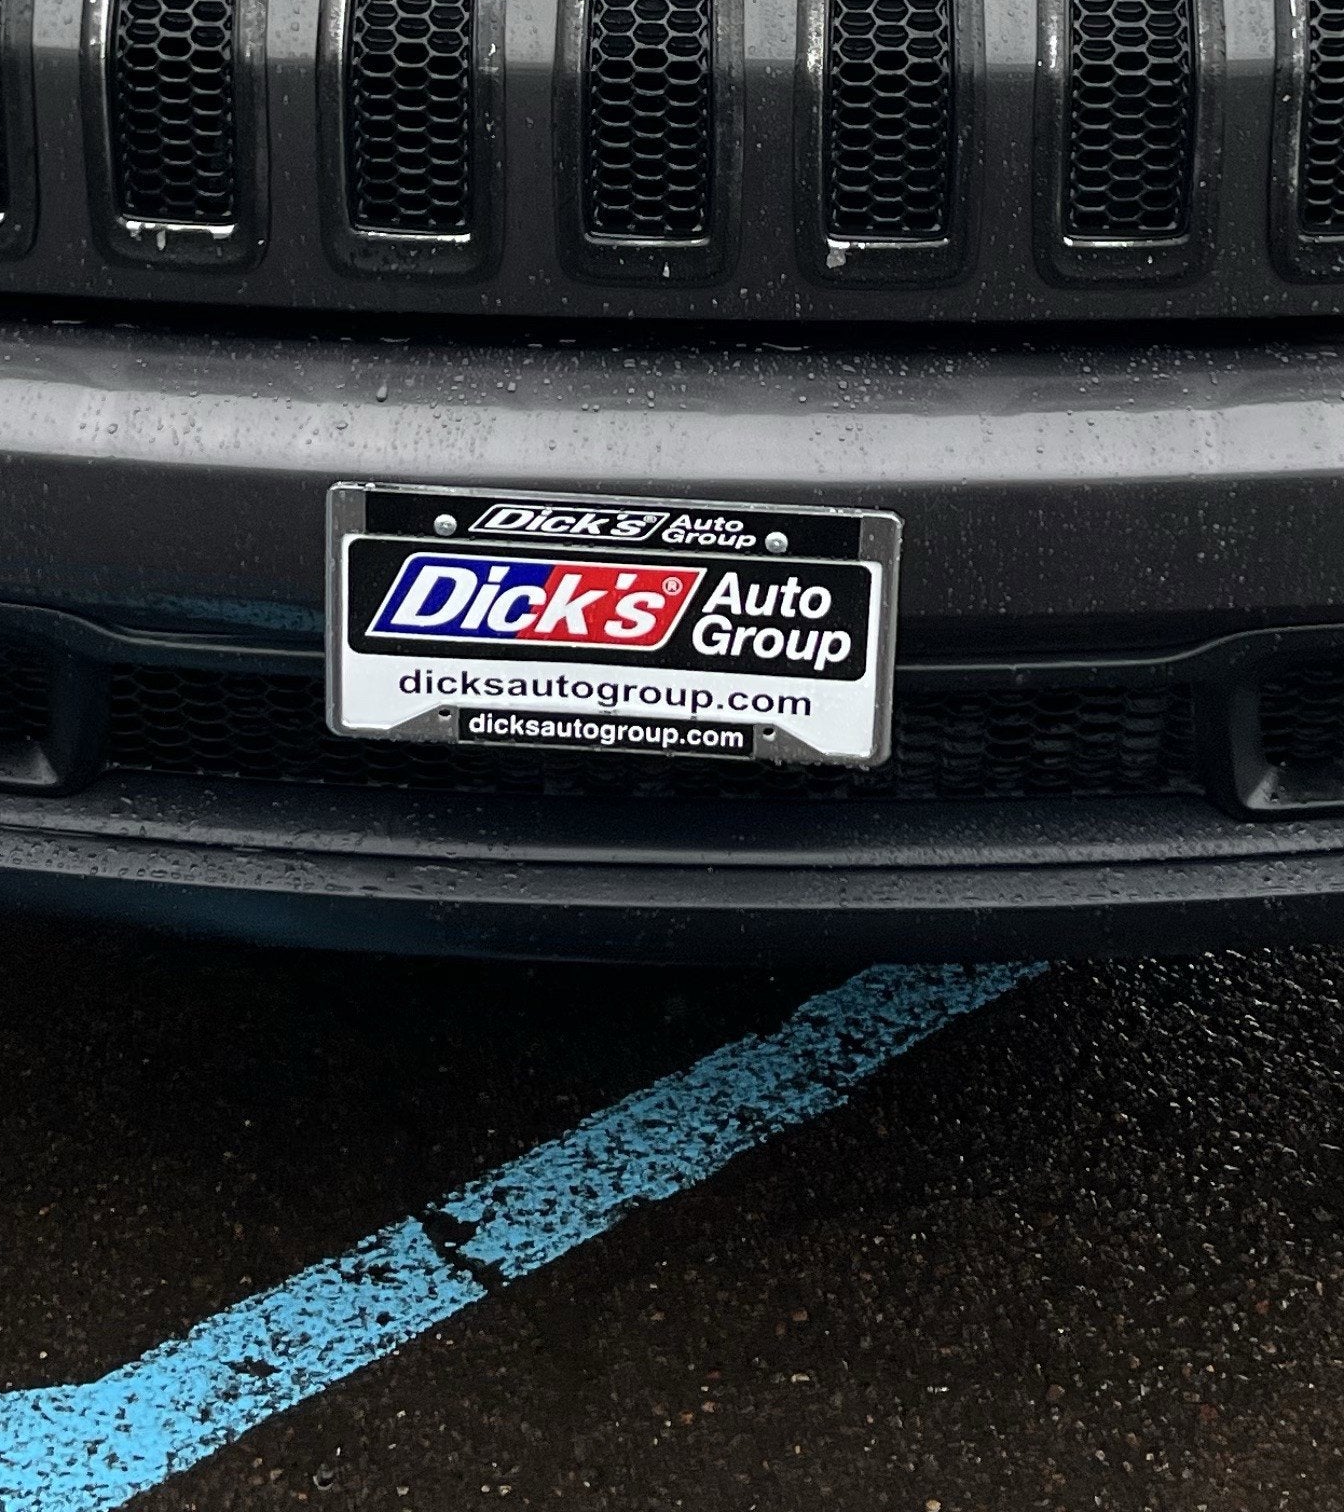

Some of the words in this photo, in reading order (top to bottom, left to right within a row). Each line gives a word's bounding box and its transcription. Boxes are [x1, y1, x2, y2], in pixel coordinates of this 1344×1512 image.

[661, 528, 757, 550] Group
[668, 514, 744, 533] Auto
[390, 564, 667, 639] Dick's
[702, 571, 832, 619] Auto
[692, 614, 852, 671] Group
[398, 668, 812, 717] dicksautogroup.com
[468, 712, 745, 749] dicksautogroup.com
